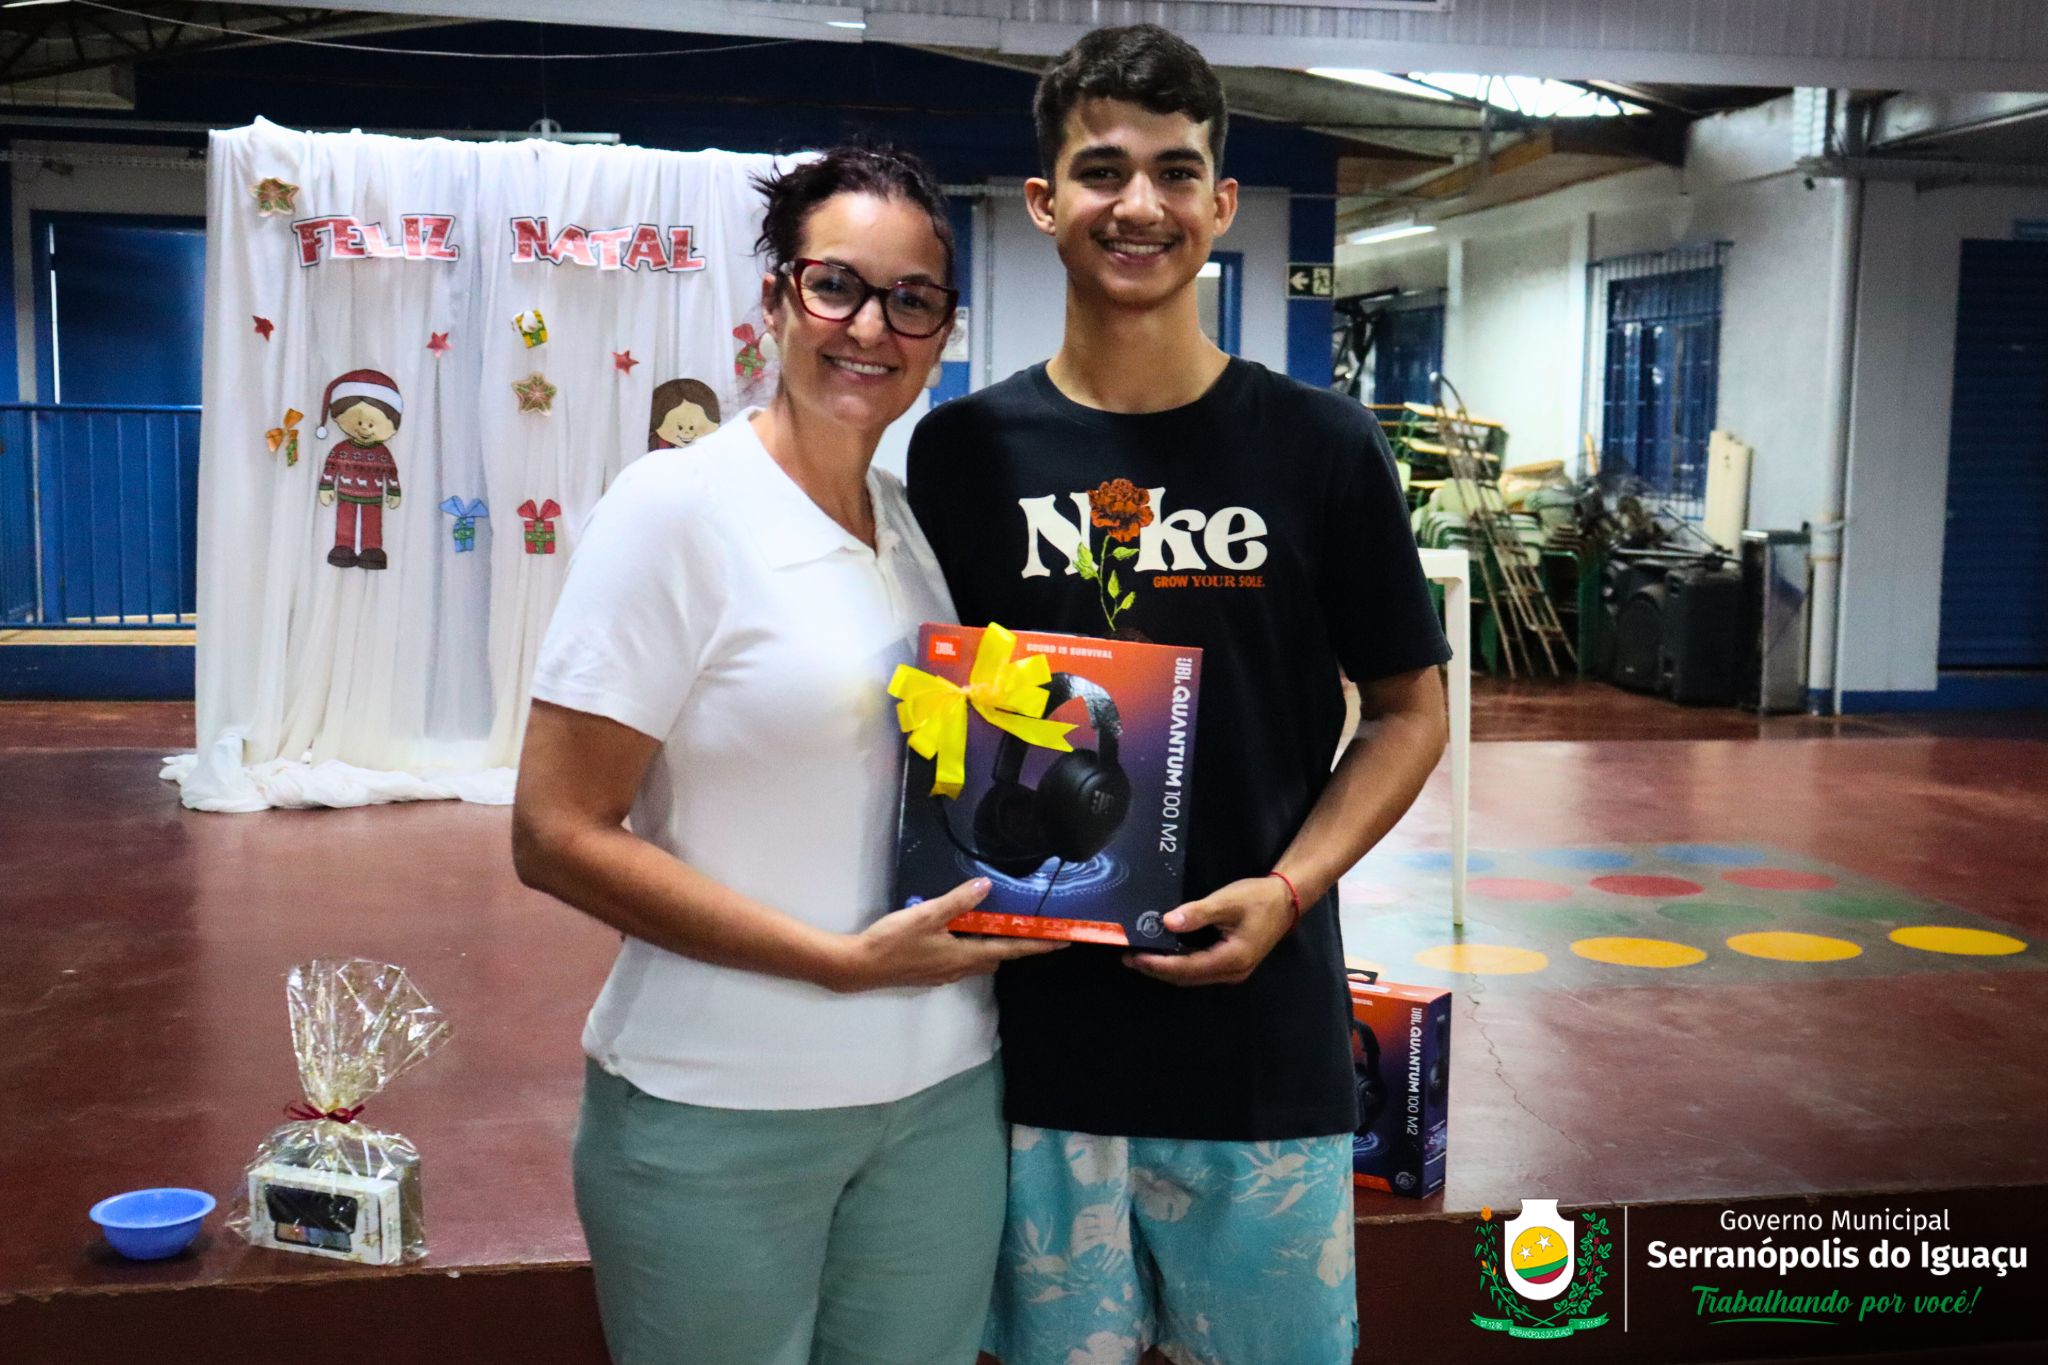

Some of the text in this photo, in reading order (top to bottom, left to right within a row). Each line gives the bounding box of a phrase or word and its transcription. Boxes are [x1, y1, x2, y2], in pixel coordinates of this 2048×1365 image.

[291, 214, 706, 272] FELIZ NATAL
[1153, 575, 1188, 588] GROW
[1191, 575, 1236, 588] YOUR
[1026, 643, 1113, 659] SOUND IS SURVIVAL
[1165, 686, 1191, 787] QUANTUM
[1163, 790, 1181, 818] 100
[1159, 823, 1179, 853] M2
[1408, 1026, 1422, 1093] QUANTUM
[1407, 1095, 1420, 1113] 100
[1406, 1115, 1420, 1136] M2
